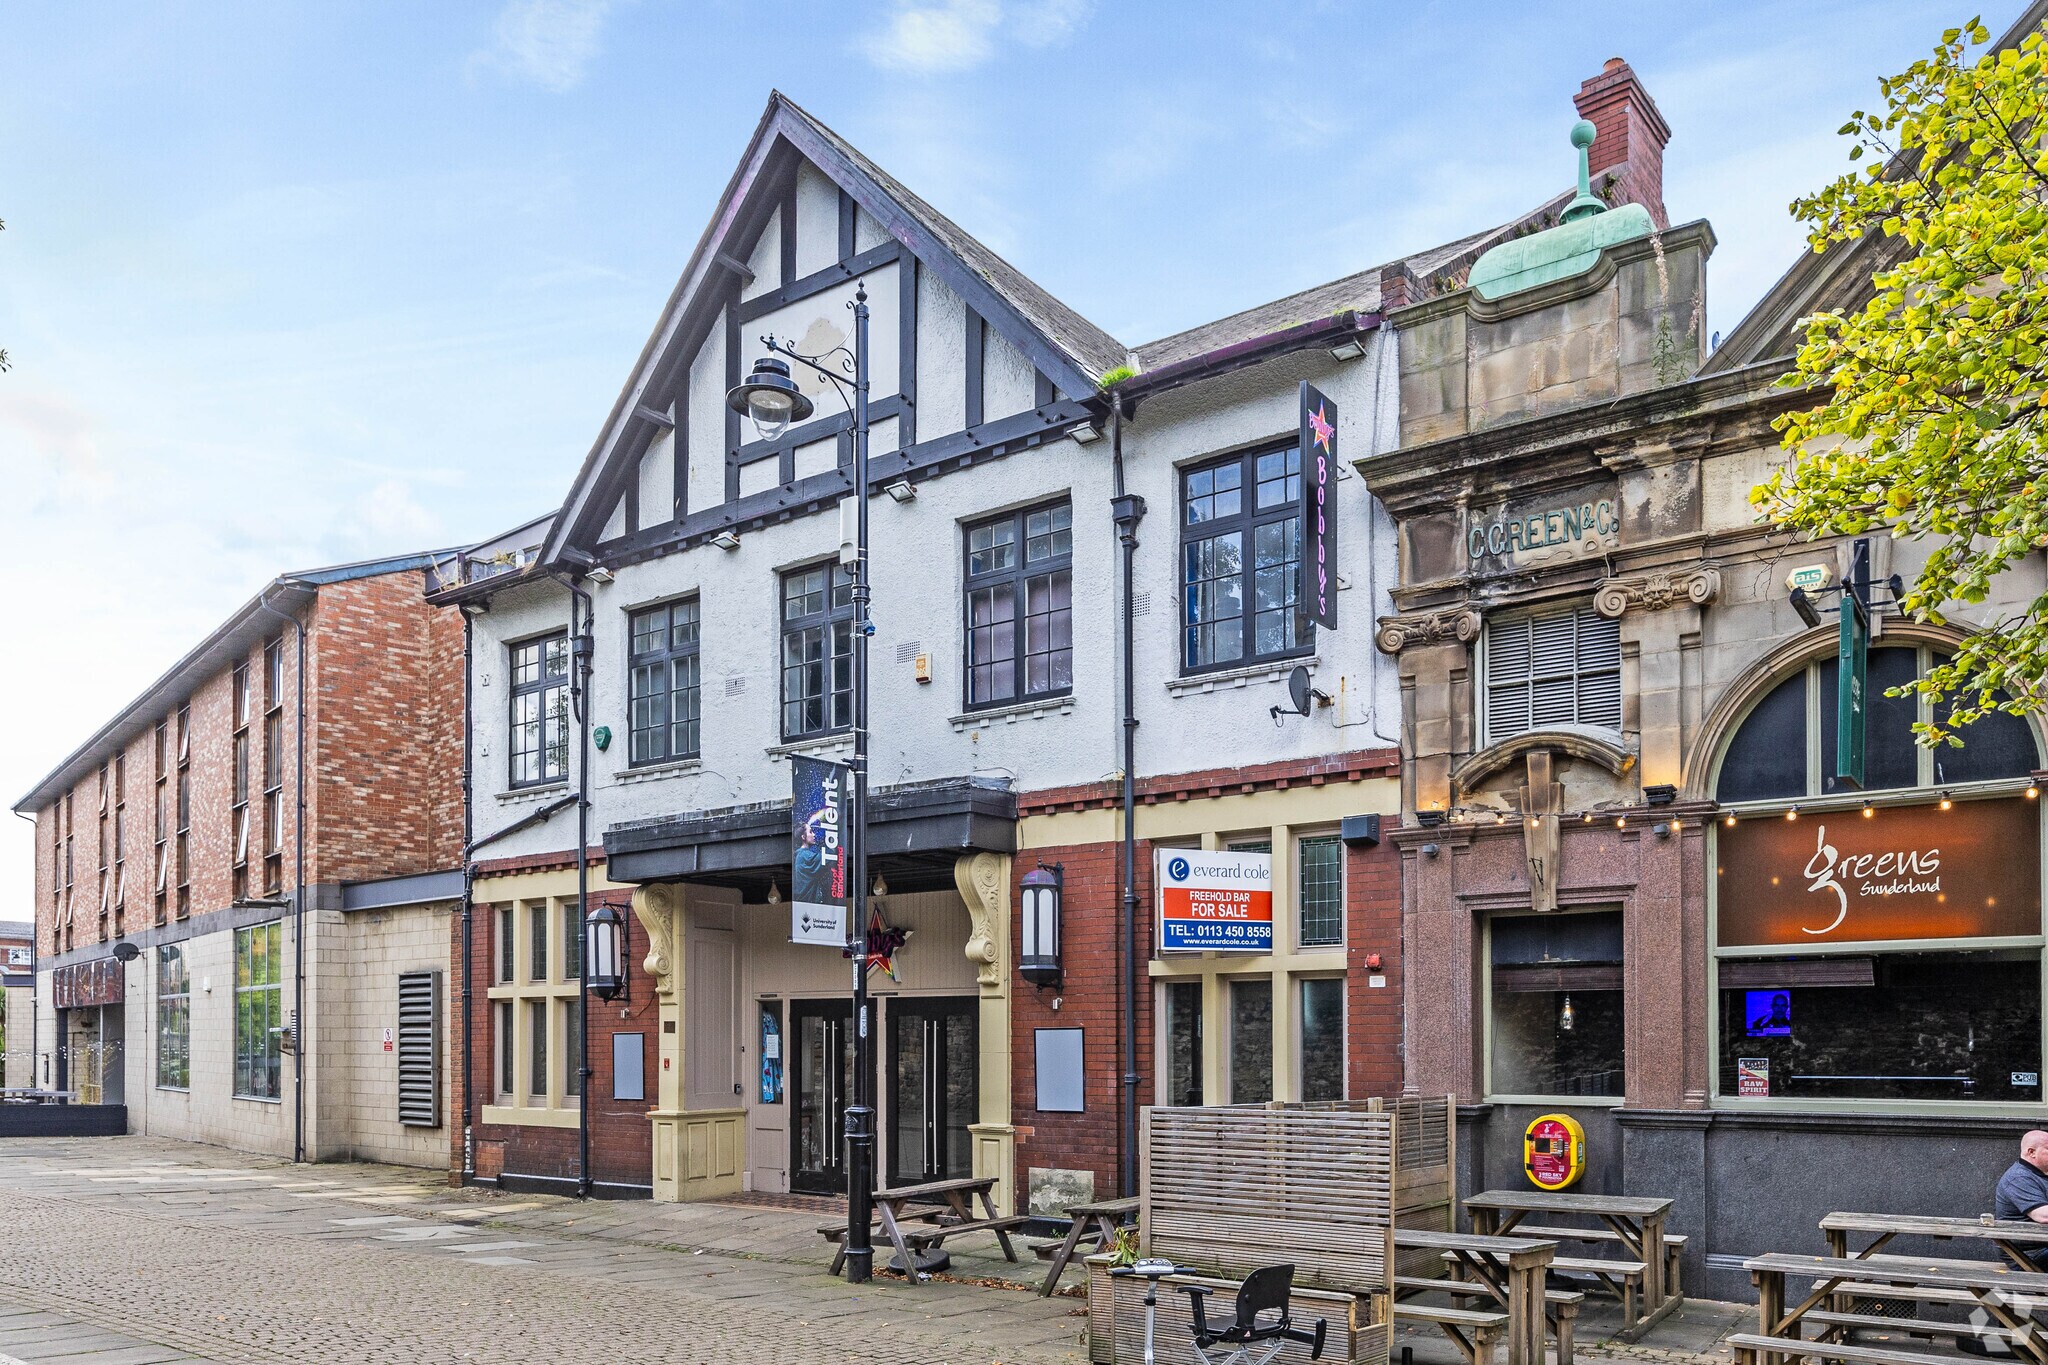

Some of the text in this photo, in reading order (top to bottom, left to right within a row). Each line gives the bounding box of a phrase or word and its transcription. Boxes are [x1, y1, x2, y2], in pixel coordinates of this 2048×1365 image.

[1317, 456, 1327, 616] Bobby's
[821, 777, 839, 866] Talent
[1193, 863, 1241, 877] everard
[1244, 864, 1269, 879] cole
[1802, 825, 1940, 934] greens
[1860, 876, 1940, 896] Sunderland
[1189, 891, 1250, 903] FREEHOLD BAR
[1191, 903, 1248, 918] FOR SALE
[812, 917, 833, 925] University
[1168, 924, 1272, 938] TEL: 0113 450 8558
[1182, 938, 1260, 946] www.everardcole.co.uk
